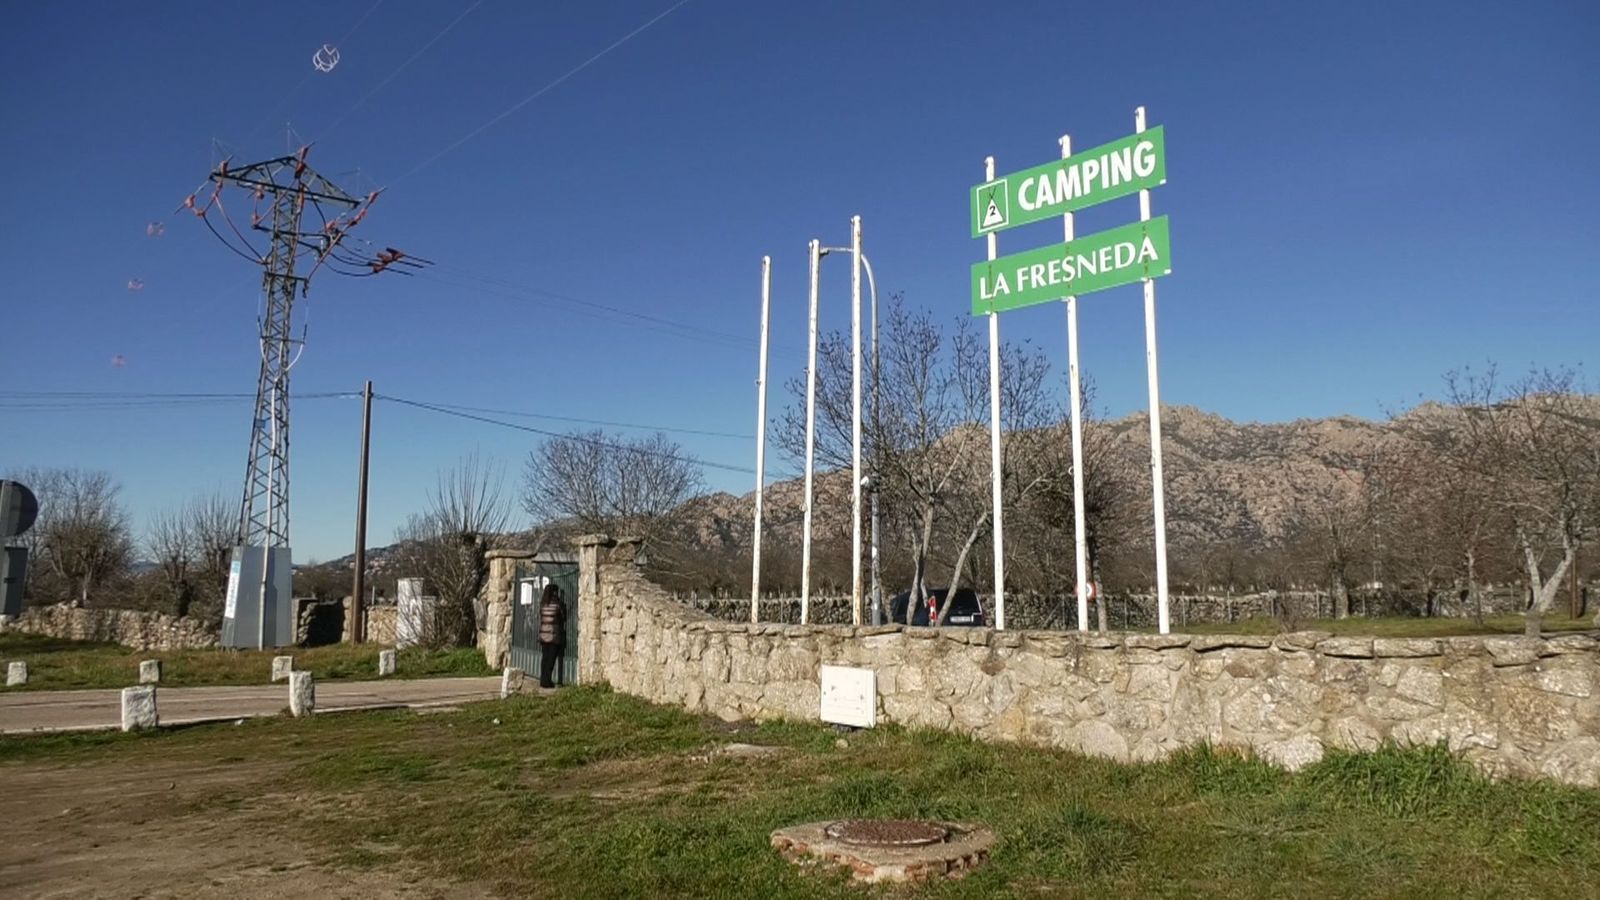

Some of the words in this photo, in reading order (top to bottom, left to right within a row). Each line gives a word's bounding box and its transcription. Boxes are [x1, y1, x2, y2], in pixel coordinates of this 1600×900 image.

[1018, 140, 1156, 211] CAMPING
[989, 205, 996, 216] 2
[979, 272, 1010, 300] LA
[1016, 236, 1158, 292] FRESNEDA
